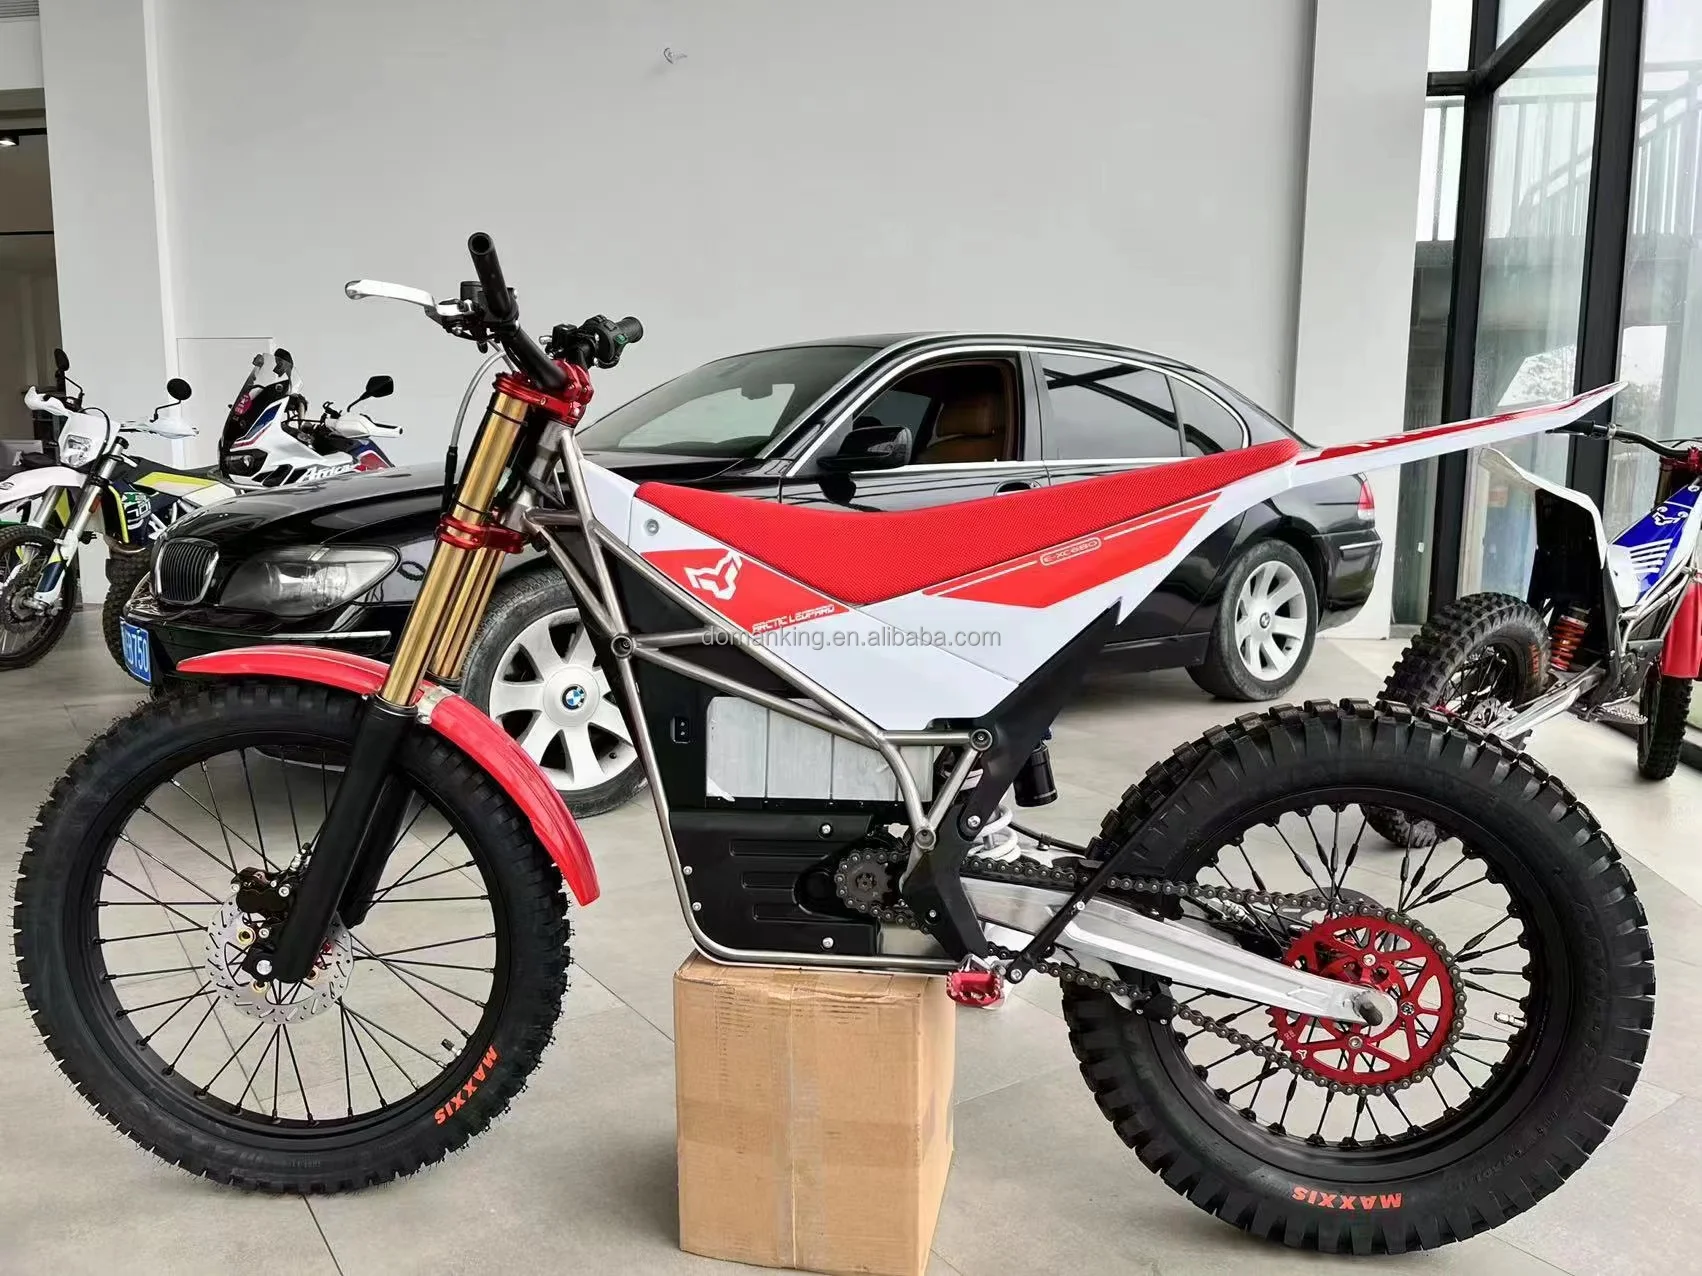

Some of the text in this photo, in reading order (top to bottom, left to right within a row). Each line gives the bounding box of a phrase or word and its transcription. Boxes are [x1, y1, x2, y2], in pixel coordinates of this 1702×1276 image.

[752, 604, 835, 633] ARCTIC LEOPARD
[434, 1045, 498, 1124] MAXXIS
[1291, 1186, 1402, 1210] MAXXIS
